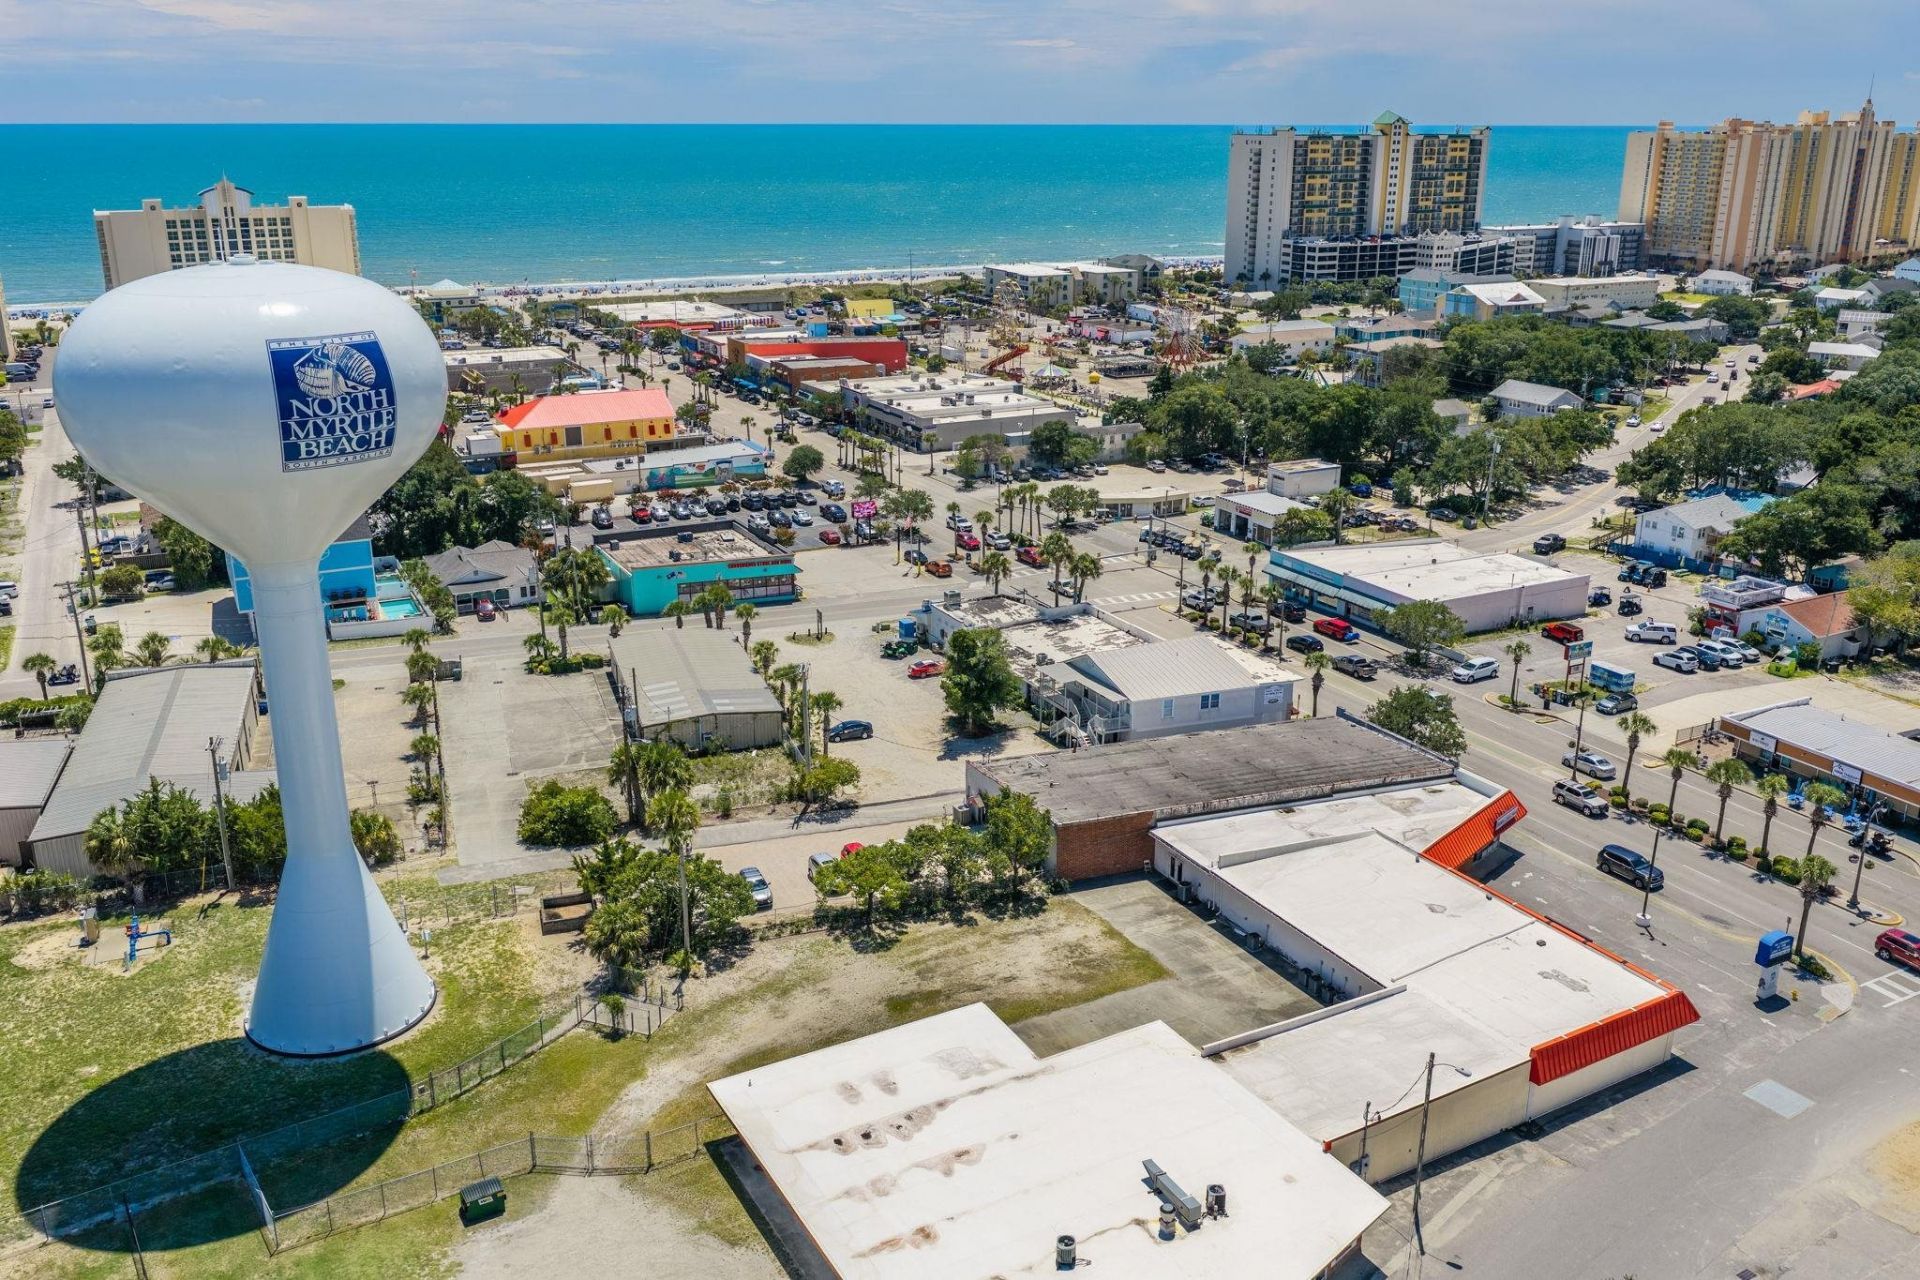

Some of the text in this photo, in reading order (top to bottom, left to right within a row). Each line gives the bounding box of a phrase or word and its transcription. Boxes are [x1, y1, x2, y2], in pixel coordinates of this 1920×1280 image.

[289, 388, 389, 419] NORTH
[288, 409, 395, 440] MYRTLE
[298, 429, 387, 459] BEACH
[285, 460, 328, 469] SOUTH
